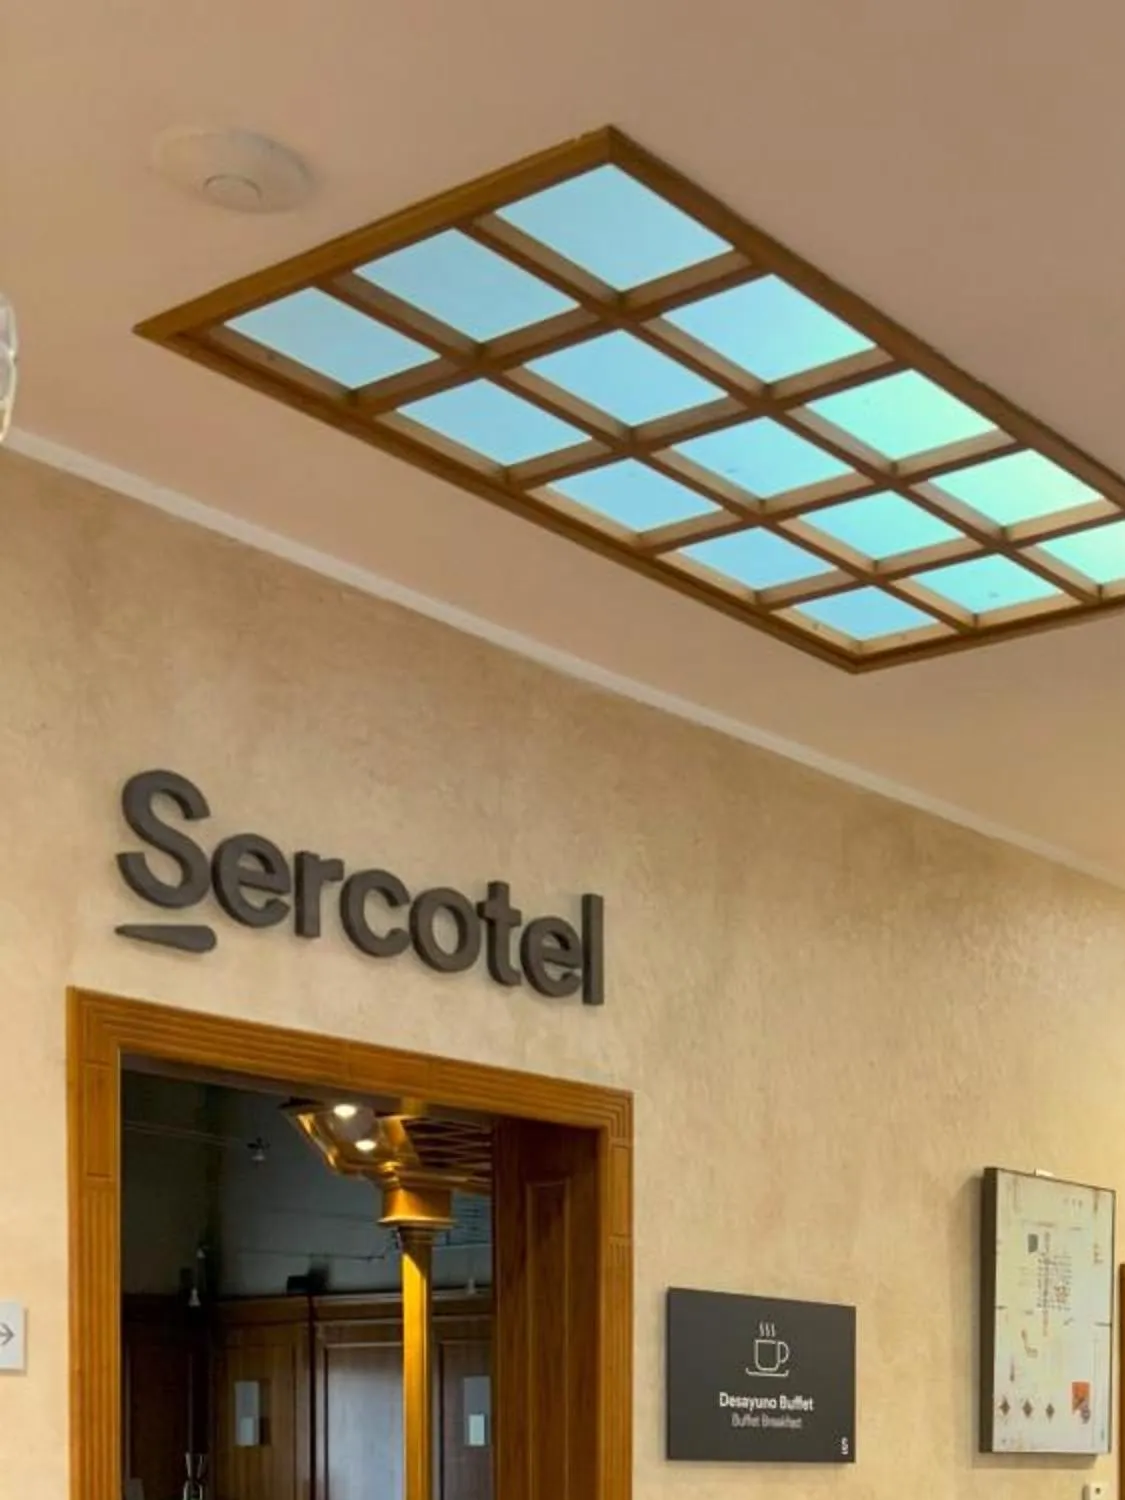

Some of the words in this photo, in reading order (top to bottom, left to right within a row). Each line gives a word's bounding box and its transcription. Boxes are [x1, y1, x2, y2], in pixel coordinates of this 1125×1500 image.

[115, 769, 604, 1006] Sercotel
[719, 1391, 777, 1411] Desayuno
[779, 1394, 814, 1411] Buffet
